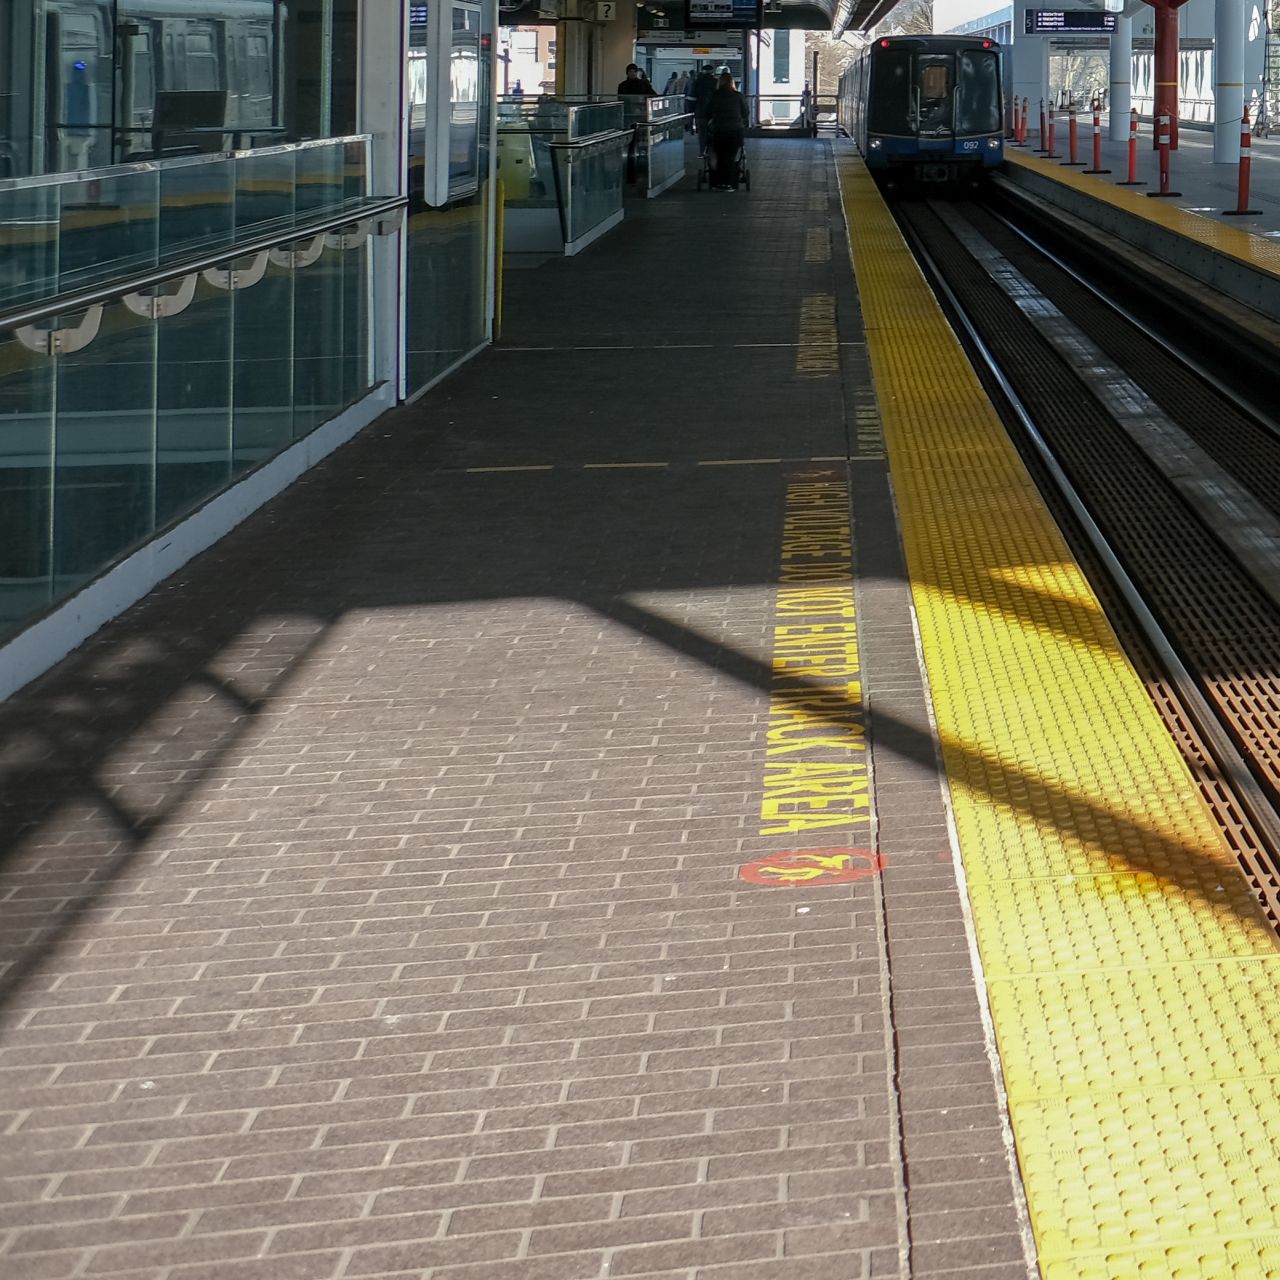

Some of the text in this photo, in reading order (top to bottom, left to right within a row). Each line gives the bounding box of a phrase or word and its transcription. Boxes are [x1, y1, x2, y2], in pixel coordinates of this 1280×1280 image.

[963, 141, 979, 150] 092
[759, 481, 872, 836] HIGH VOLTAGE DO NOT ENTER TRACK AREA
